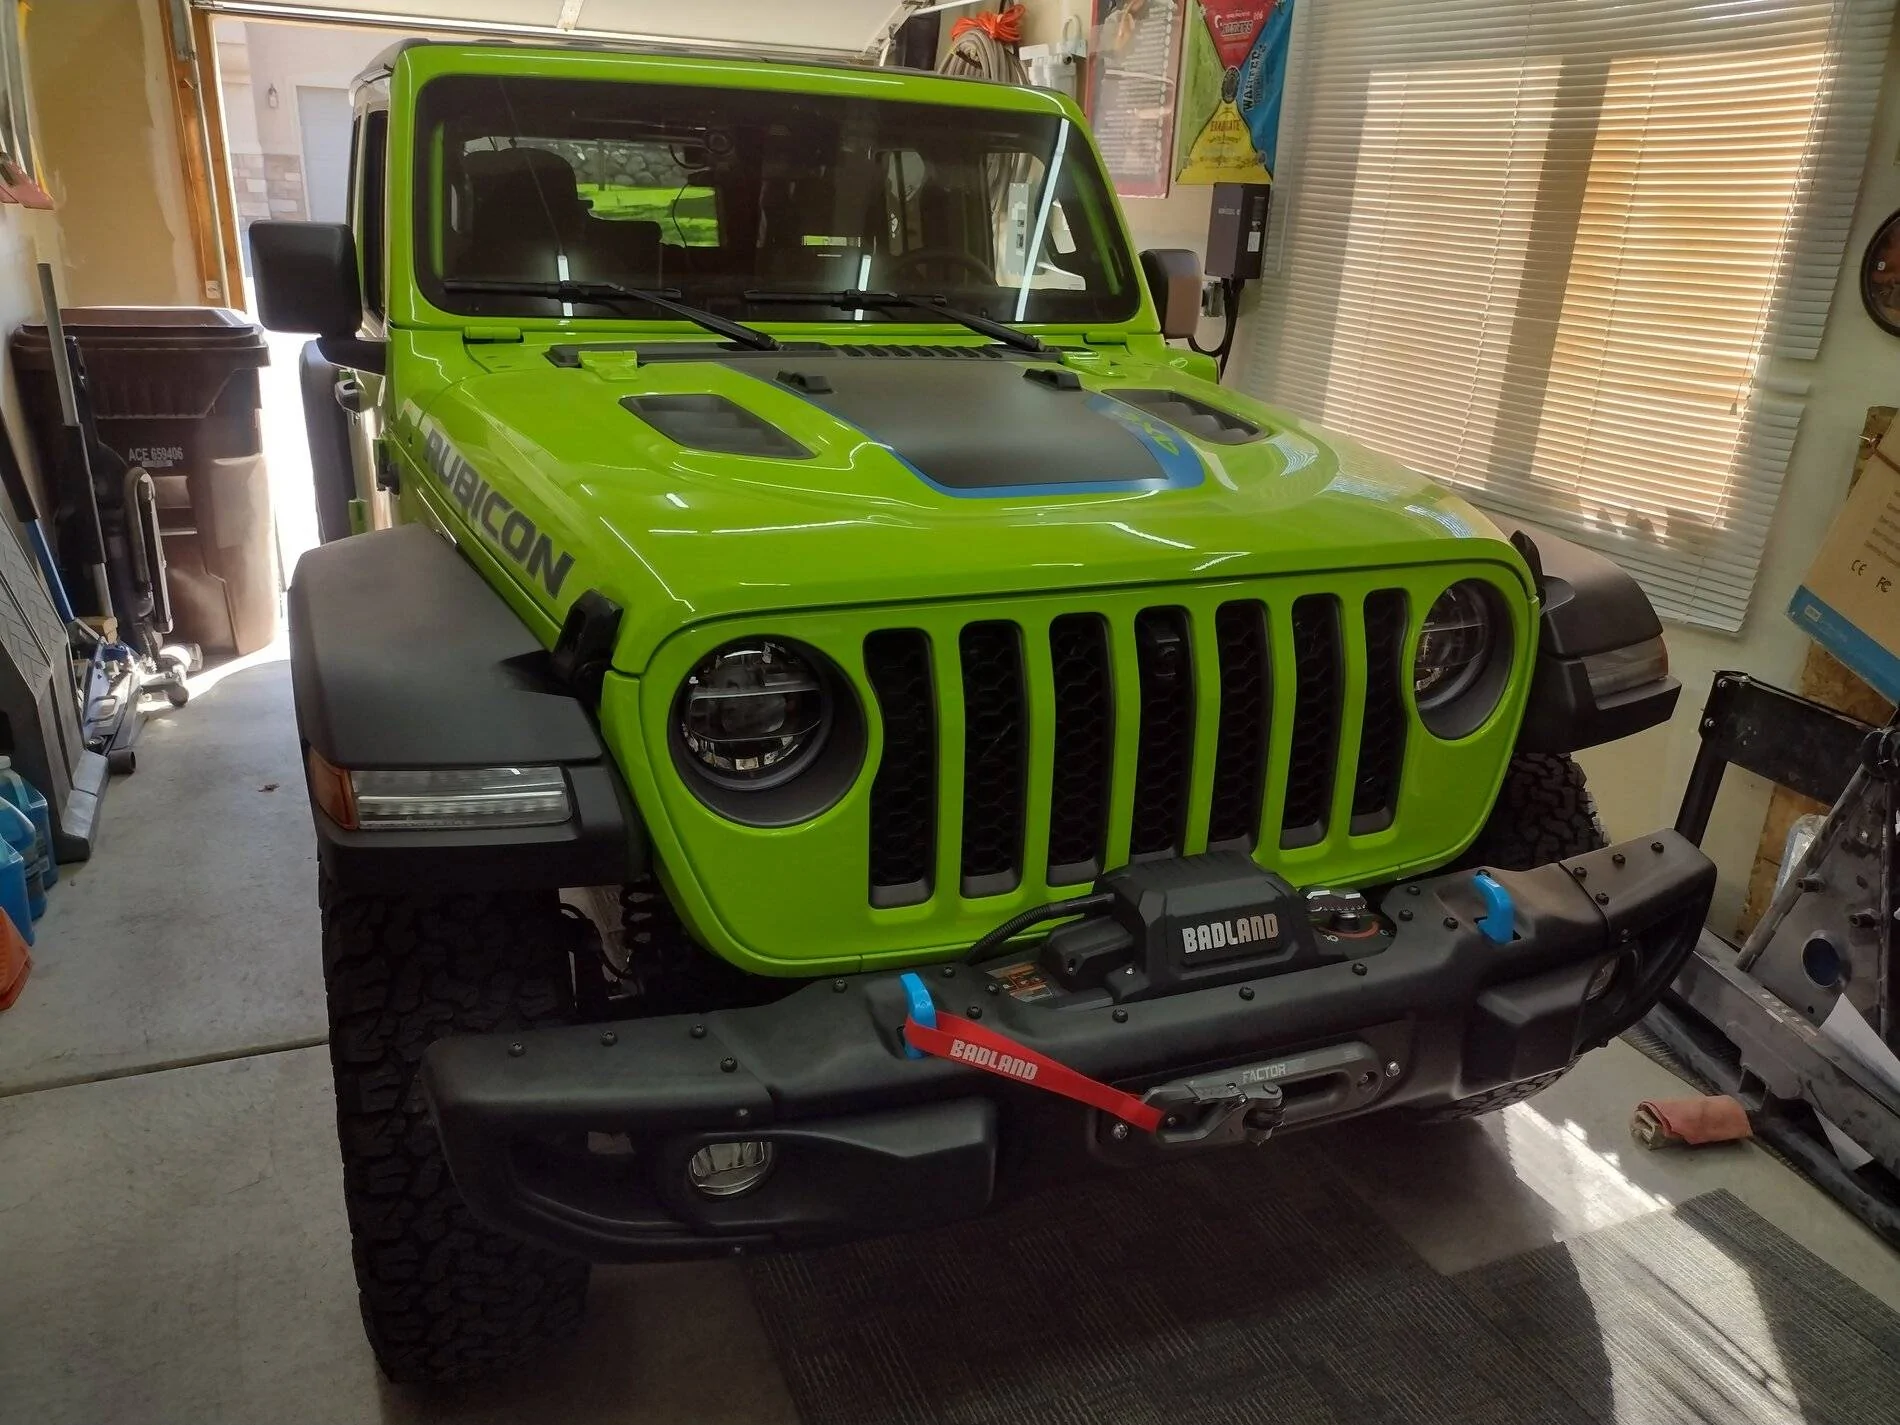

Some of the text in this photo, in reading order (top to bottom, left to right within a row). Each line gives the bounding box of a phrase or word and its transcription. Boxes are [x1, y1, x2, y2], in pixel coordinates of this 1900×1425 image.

[128, 447, 150, 462] ACE
[424, 428, 576, 600] RUBICON
[1181, 912, 1280, 954] BADLAND
[949, 1038, 1038, 1081] BADLAND
[1242, 1063, 1287, 1084] FACTOR
